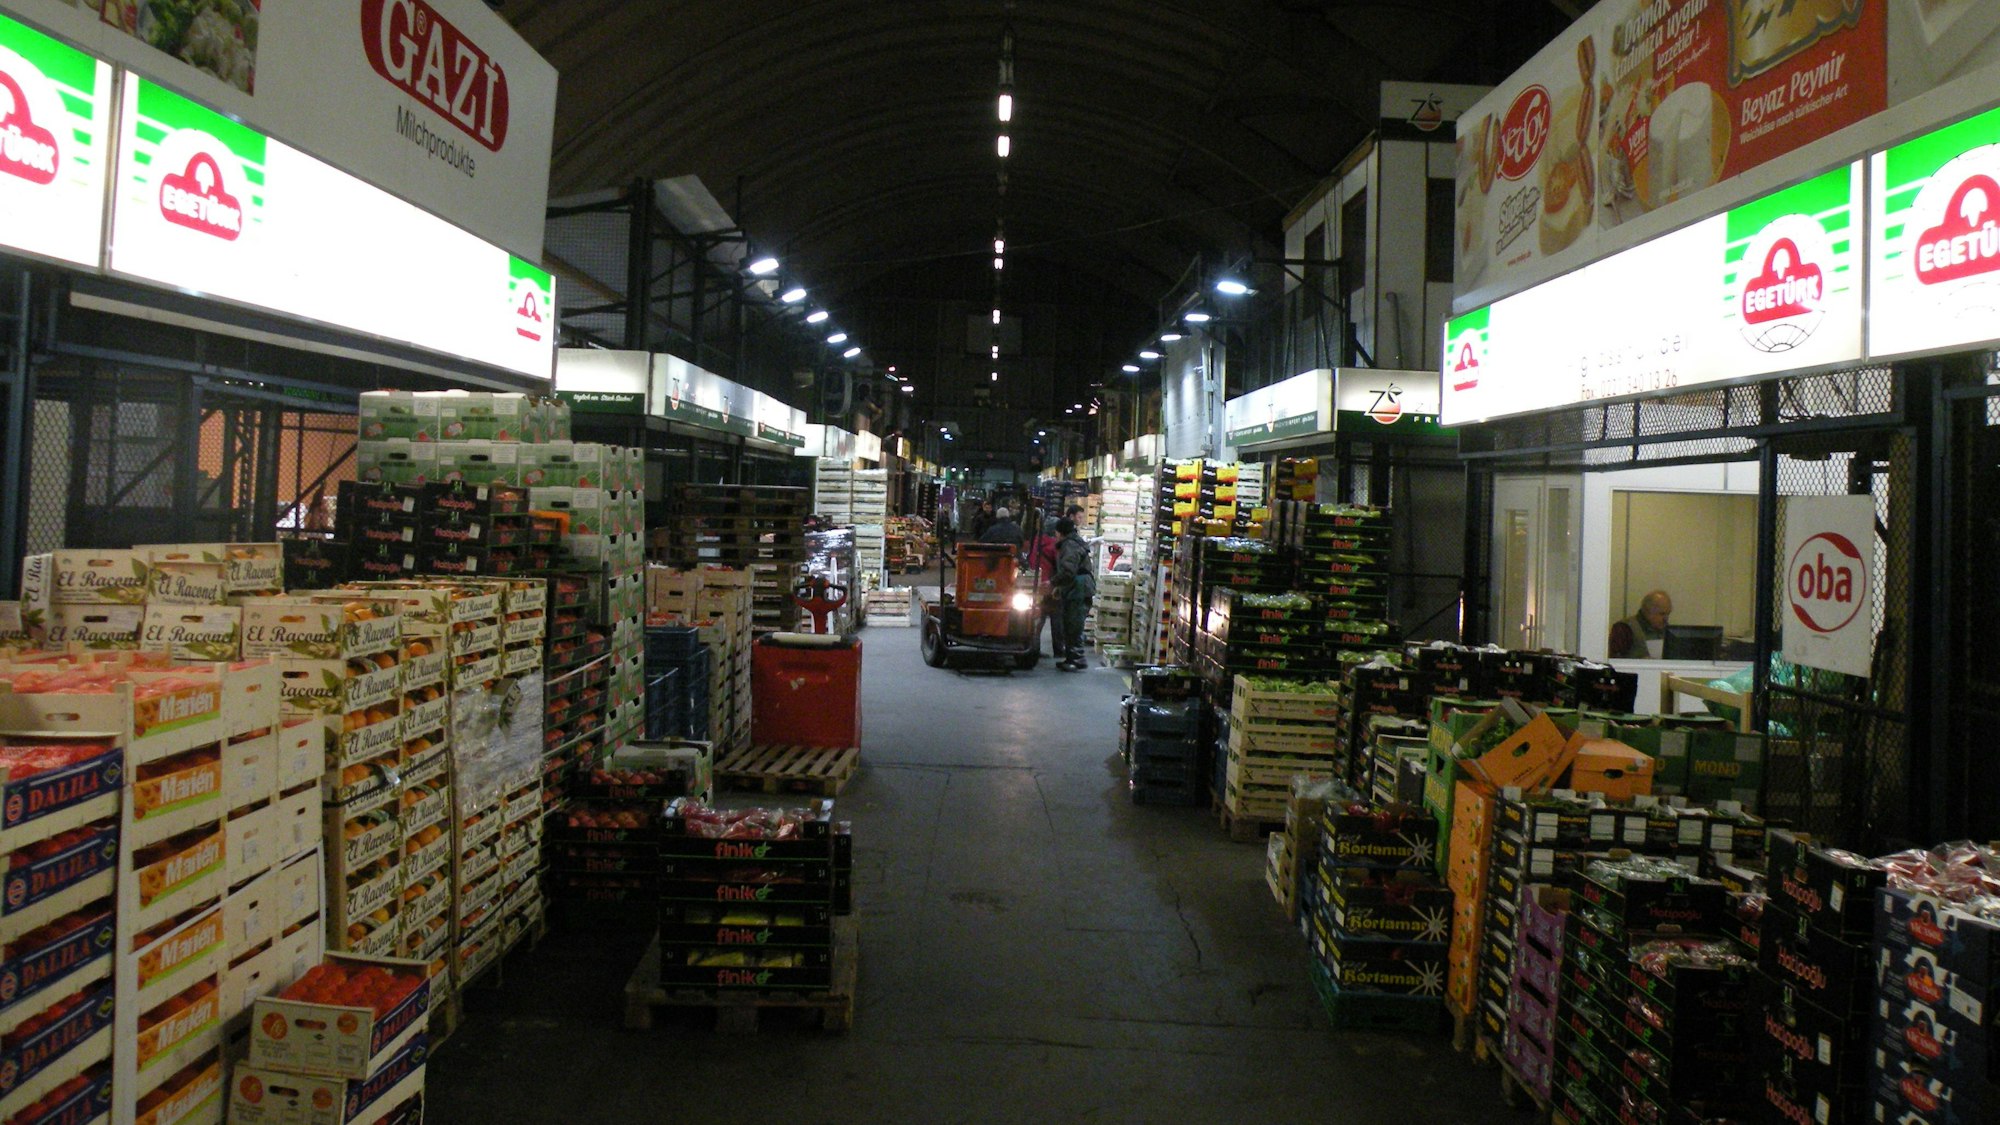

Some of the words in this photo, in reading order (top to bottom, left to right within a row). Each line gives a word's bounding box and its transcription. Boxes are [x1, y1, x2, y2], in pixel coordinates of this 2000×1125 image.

[1742, 85, 1785, 126] Beyaz
[1789, 50, 1845, 103] Peynir
[1834, 83, 1848, 100] Art
[397, 104, 475, 178] Milchprodukte
[162, 182, 241, 234] EGETÜRK
[1745, 273, 1821, 314] EGETÜRK
[57, 571, 77, 588] El
[158, 573, 174, 596] El
[174, 575, 218, 600] Raconet
[1797, 552, 1853, 604] oba
[49, 625, 68, 642] El
[146, 625, 162, 641] El
[247, 625, 265, 642] El
[28, 771, 98, 813] DALILA
[31, 849, 97, 895] DALILA
[22, 937, 91, 988] DALILA
[22, 1012, 93, 1073] DALILA
[360, 1057, 410, 1105] DALILA
